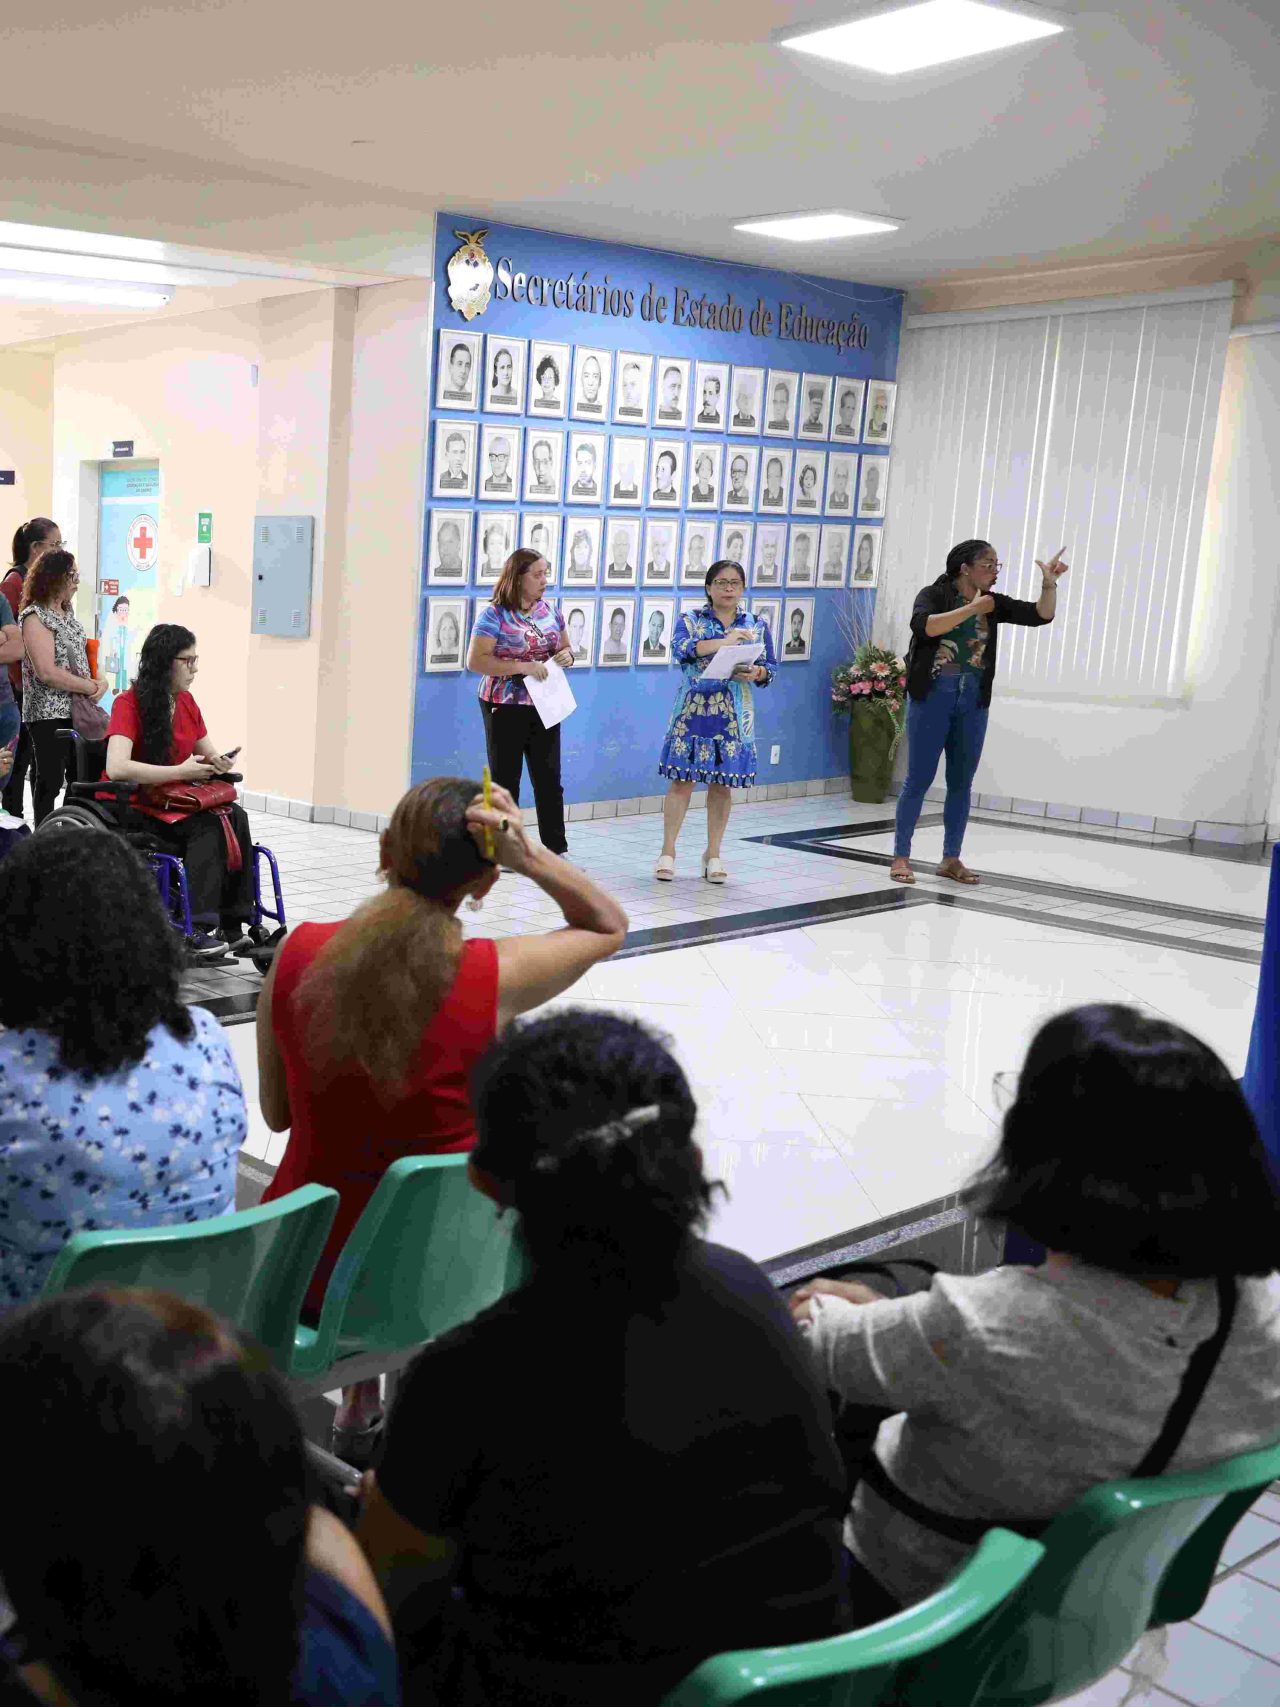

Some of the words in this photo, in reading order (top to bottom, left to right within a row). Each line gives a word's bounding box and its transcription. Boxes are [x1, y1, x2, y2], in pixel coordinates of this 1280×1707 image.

[494, 256, 634, 318] Secretários
[641, 282, 668, 324] de
[674, 286, 744, 335] Estado
[750, 299, 773, 337] de
[778, 302, 870, 354] Educação
